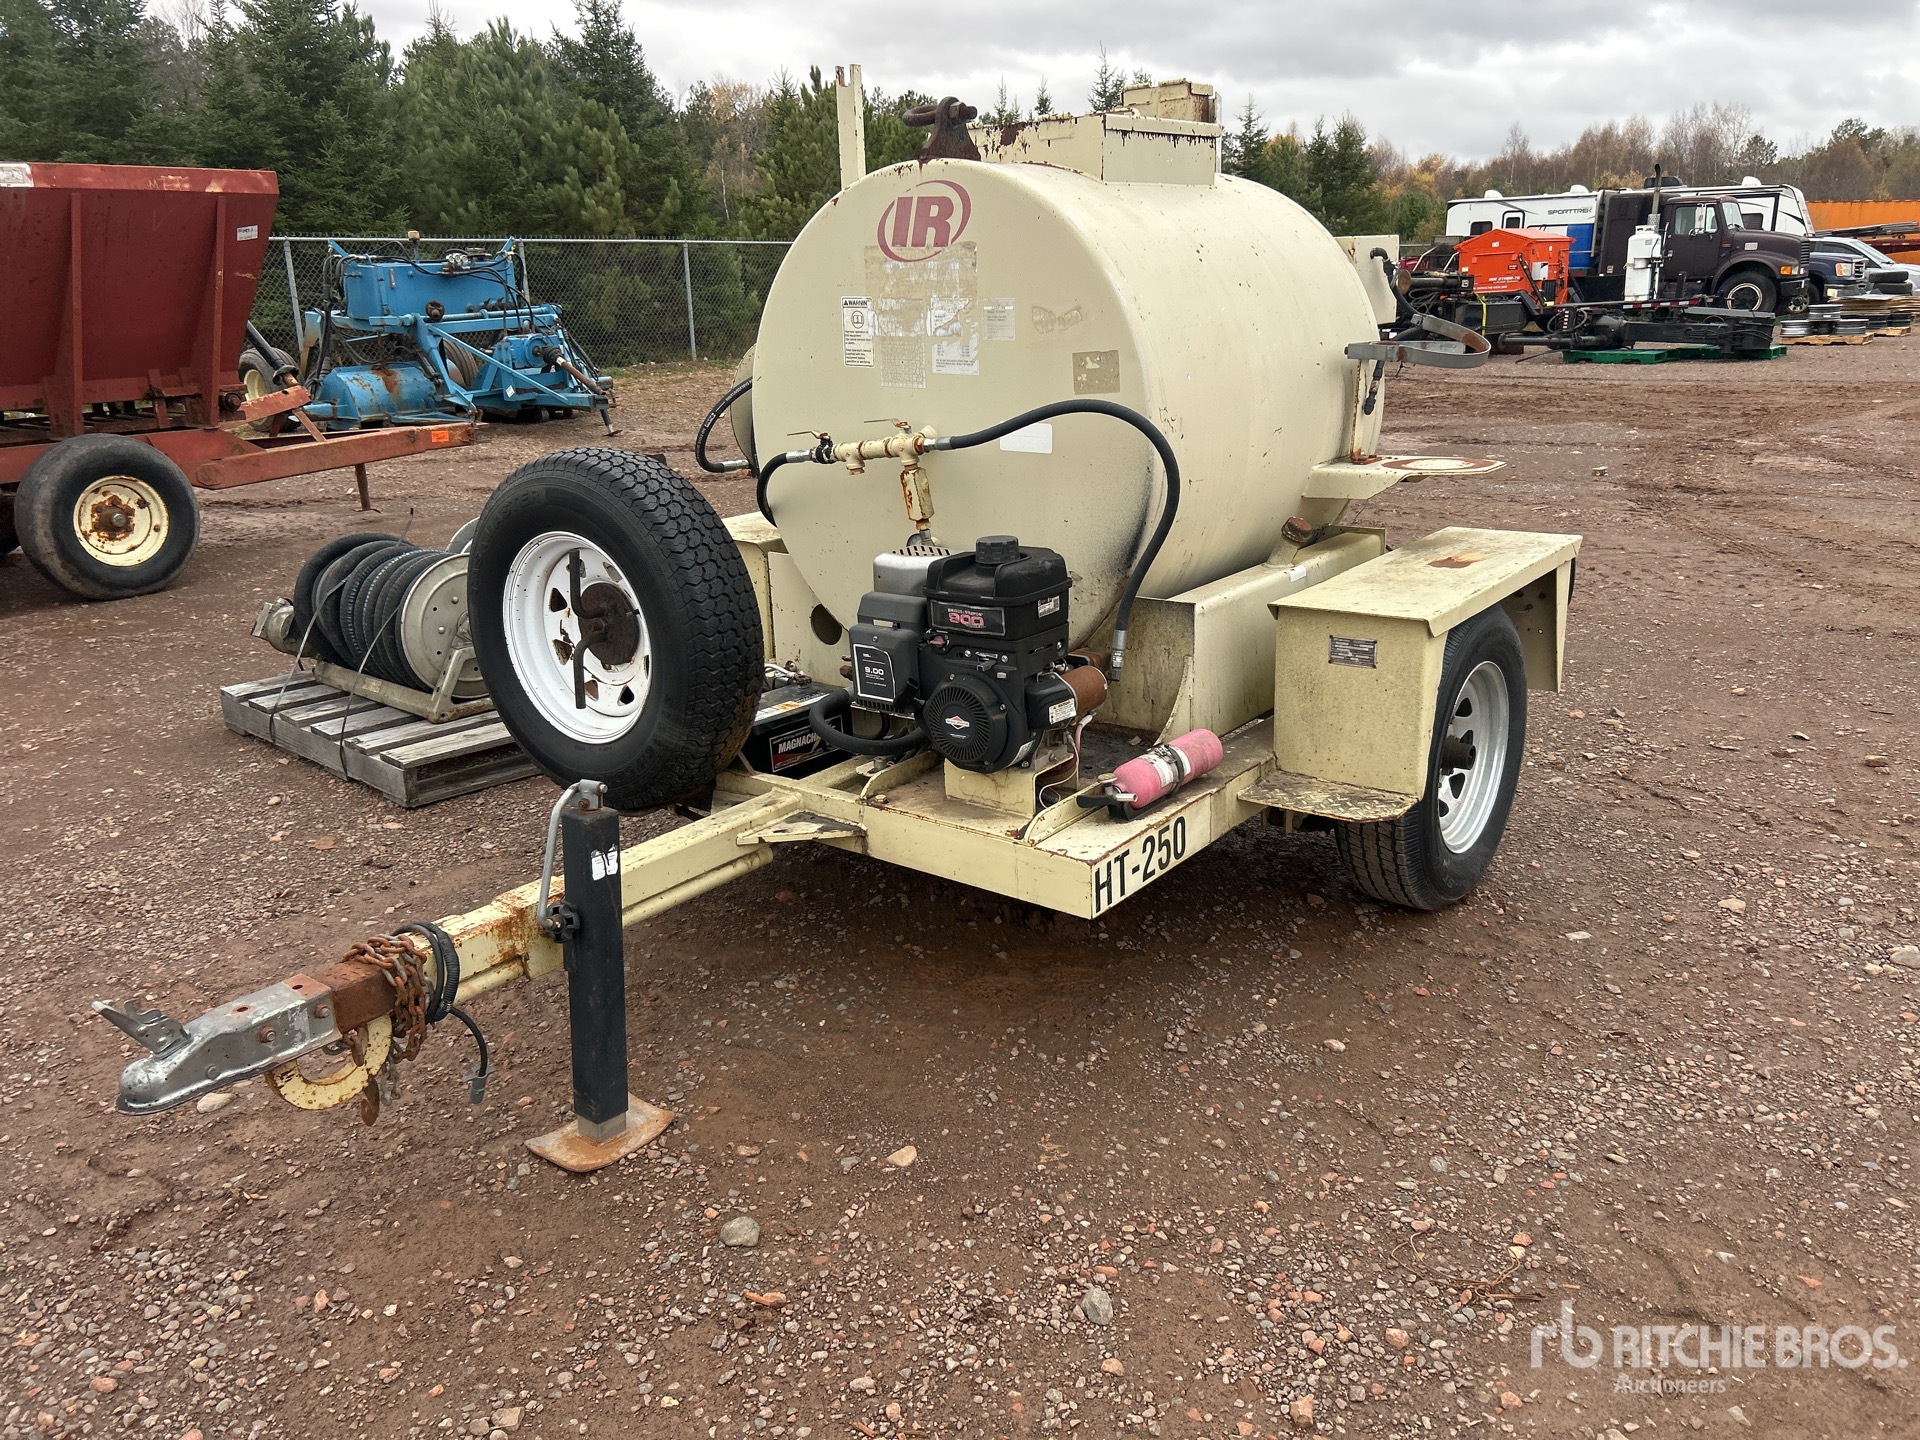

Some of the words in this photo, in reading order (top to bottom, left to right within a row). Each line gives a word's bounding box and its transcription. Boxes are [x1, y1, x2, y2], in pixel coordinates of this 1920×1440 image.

[891, 196, 954, 247] IR
[865, 666, 884, 676] 9.00
[1095, 816, 1185, 913] HT-250
